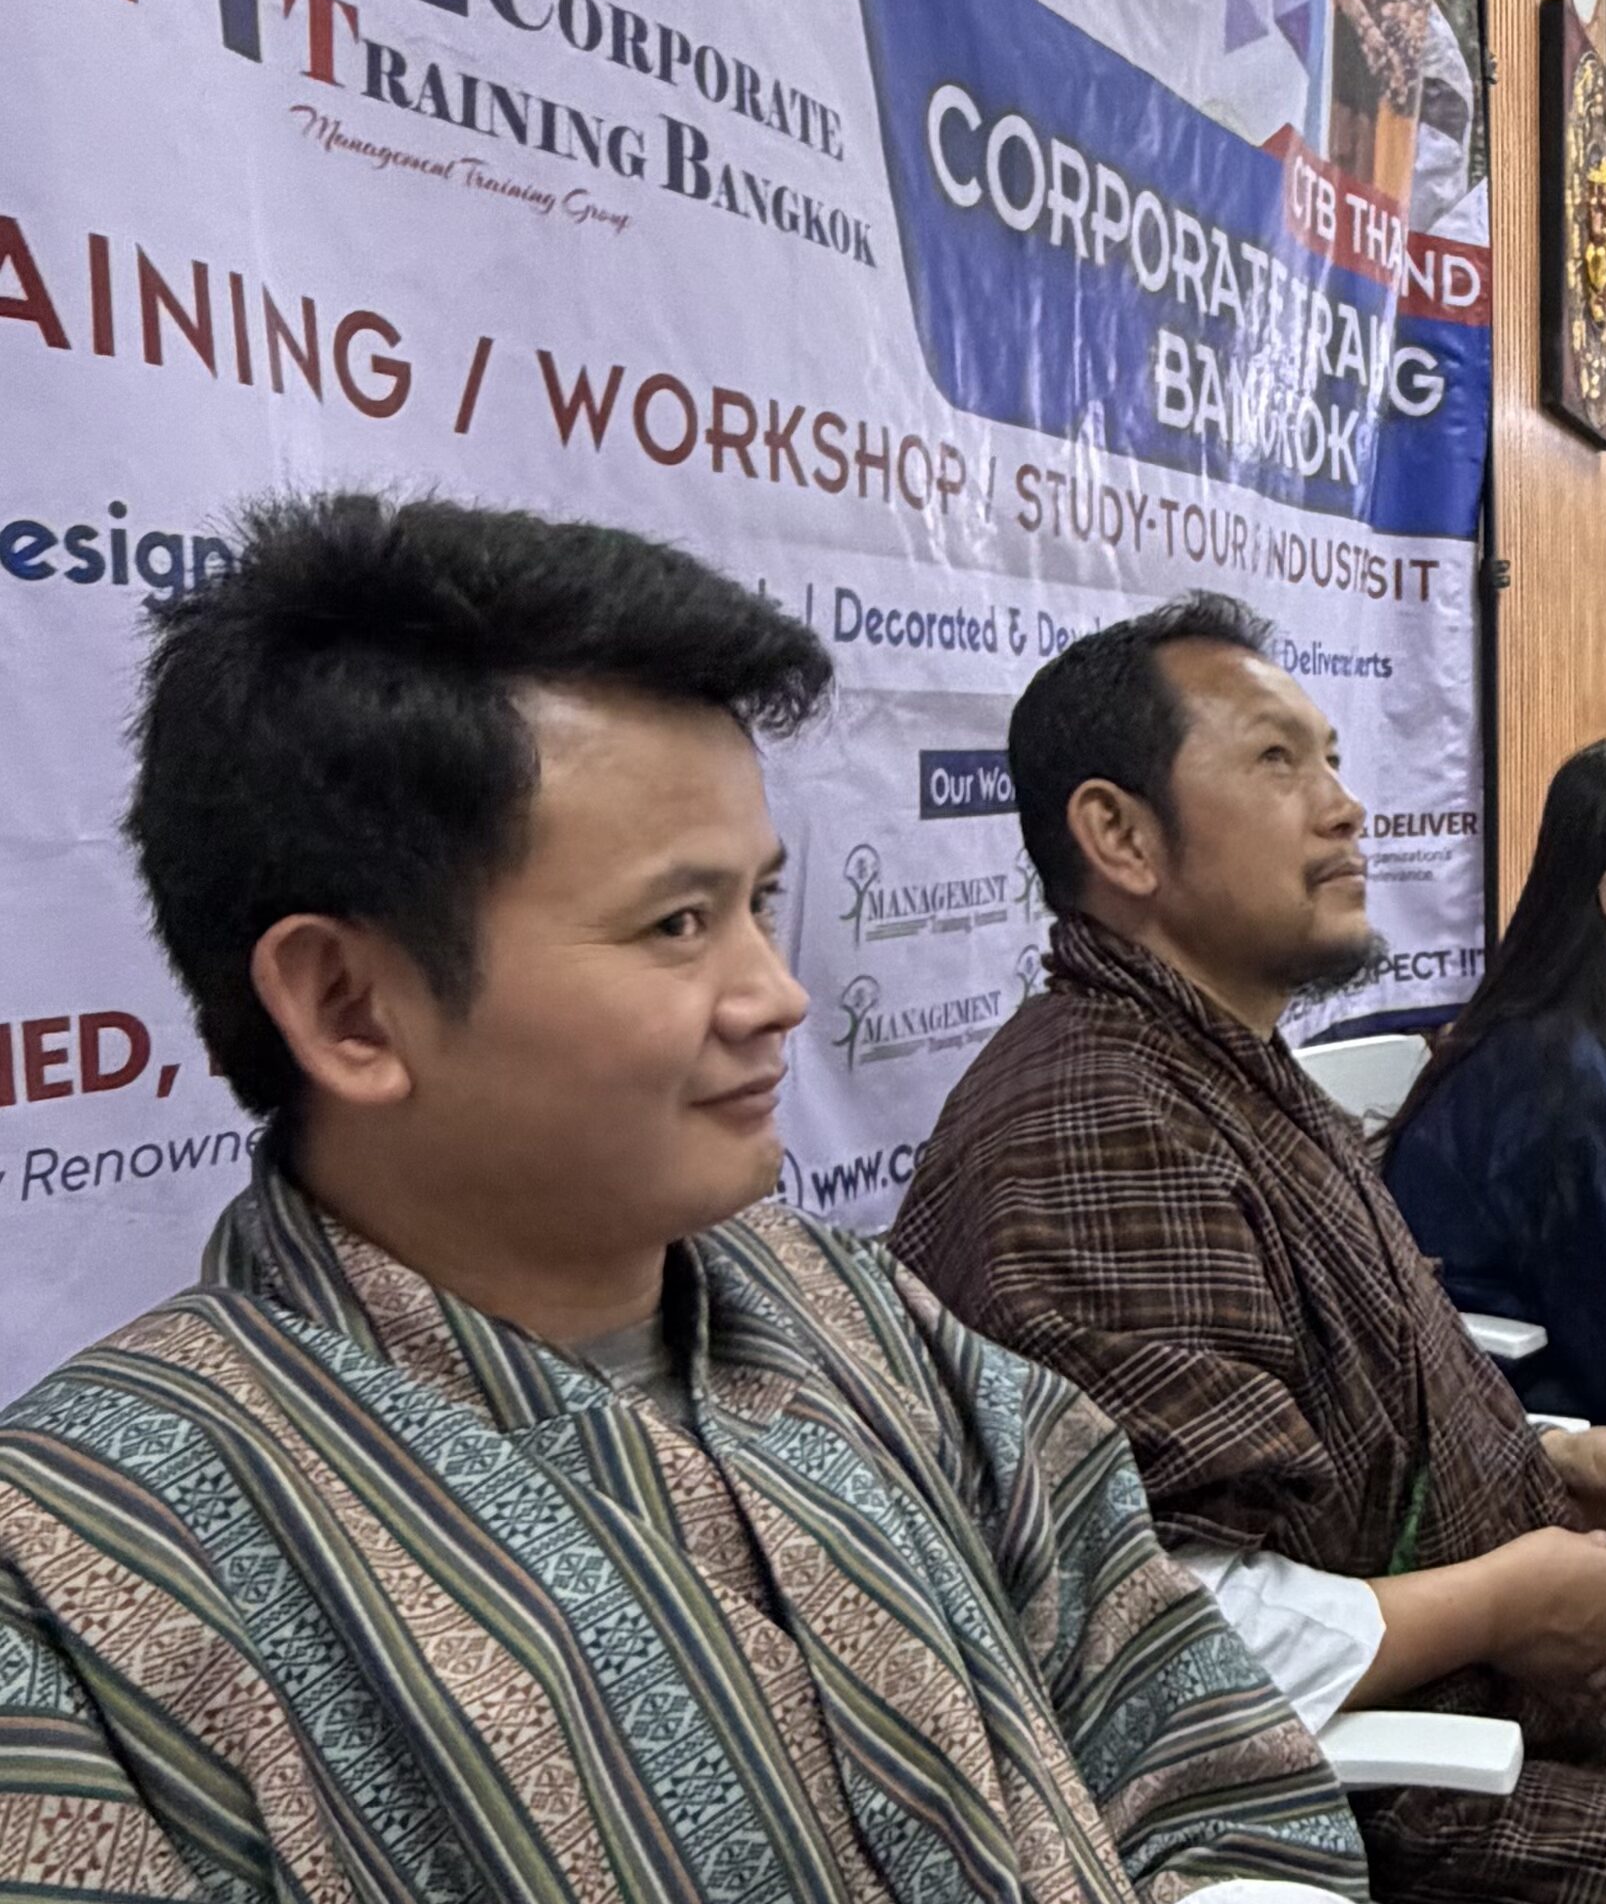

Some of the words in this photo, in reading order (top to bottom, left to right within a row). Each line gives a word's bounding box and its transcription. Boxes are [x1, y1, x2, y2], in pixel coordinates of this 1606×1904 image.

[459, 157, 558, 216] Training
[562, 188, 635, 236] Group
[661, 112, 878, 269] BANGKOK
[537, 348, 969, 516] WORKSHOP
[834, 585, 998, 654] Decorated
[930, 767, 974, 806] Our
[1374, 811, 1479, 839] DELIVER
